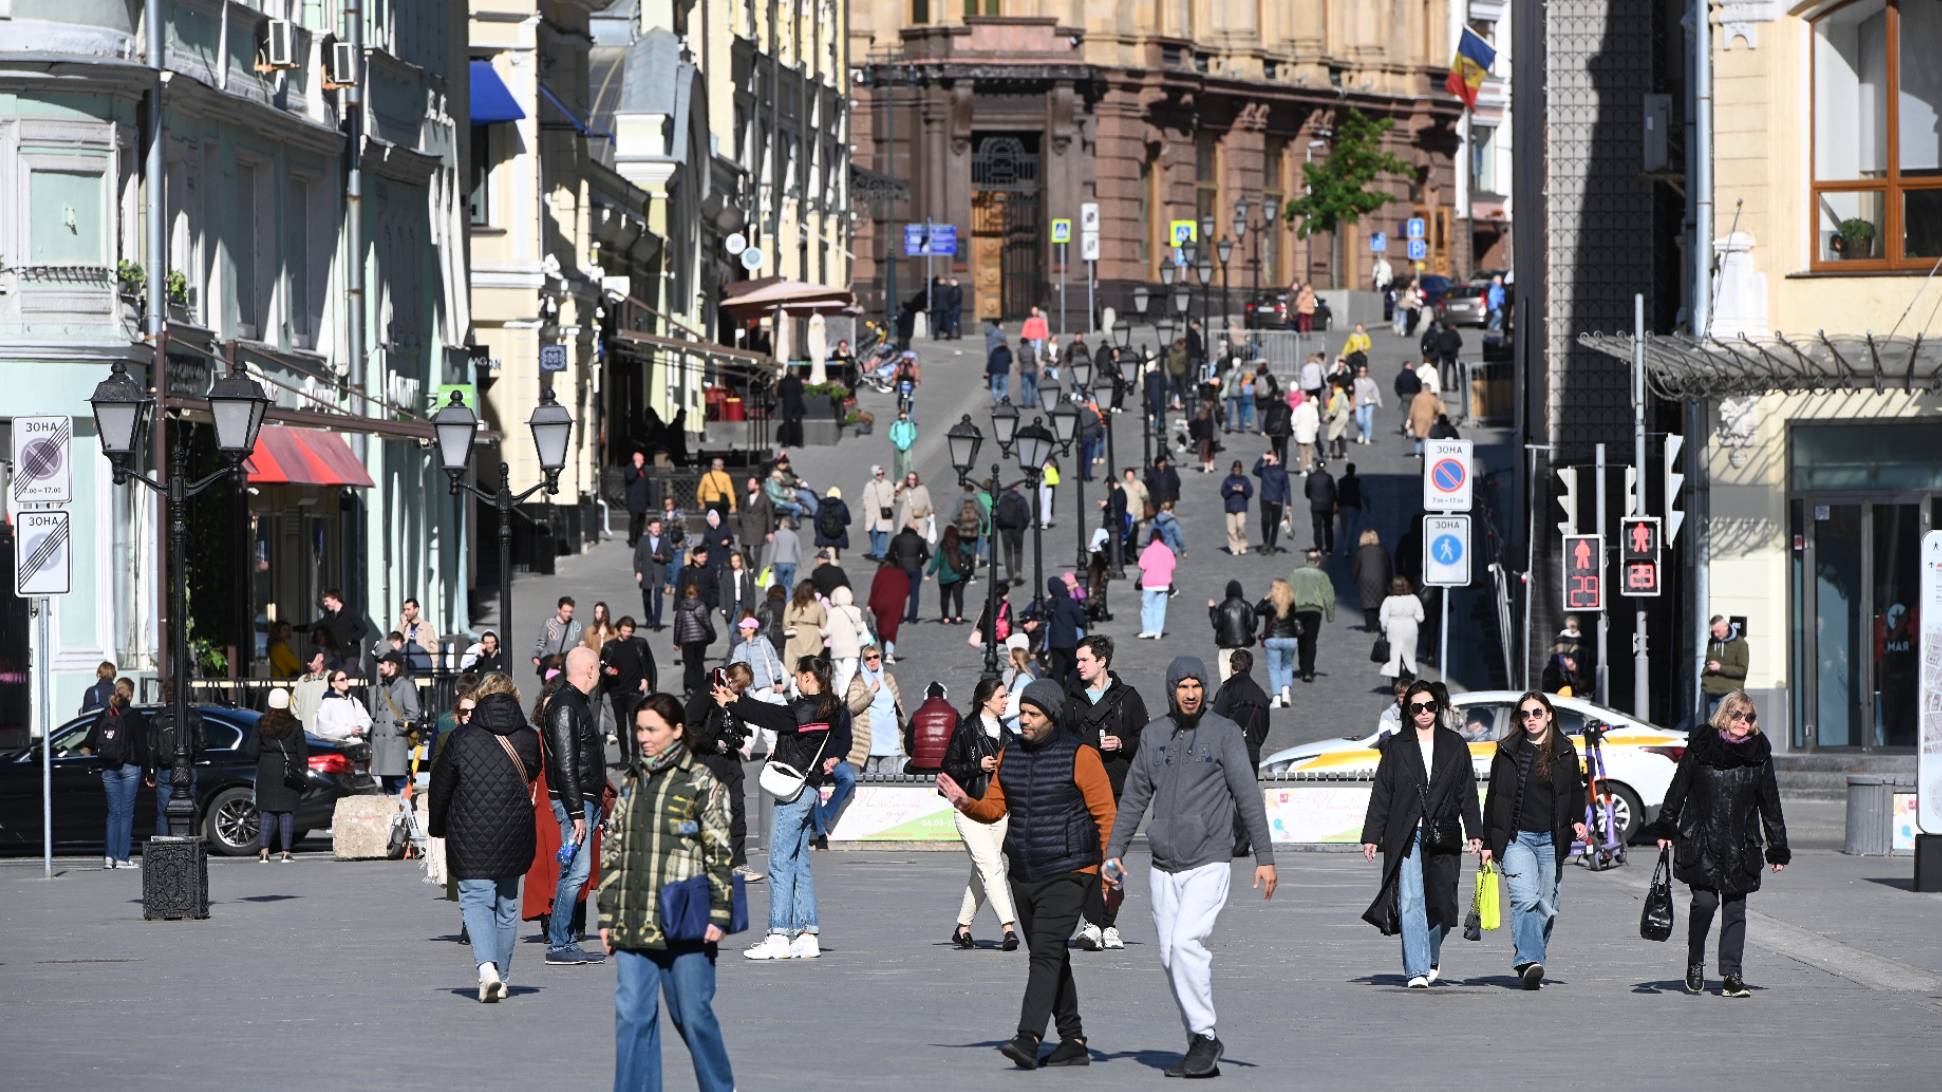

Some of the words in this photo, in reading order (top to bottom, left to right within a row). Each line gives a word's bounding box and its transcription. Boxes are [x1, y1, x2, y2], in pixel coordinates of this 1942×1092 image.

[26, 422, 58, 433] ЗОНА
[1436, 446, 1463, 454] ЗОНА
[28, 516, 59, 526] ЗОНА
[1435, 521, 1460, 529] ЗОНА
[1570, 575, 1599, 606] 29
[1887, 640, 1910, 652] МАЯ
